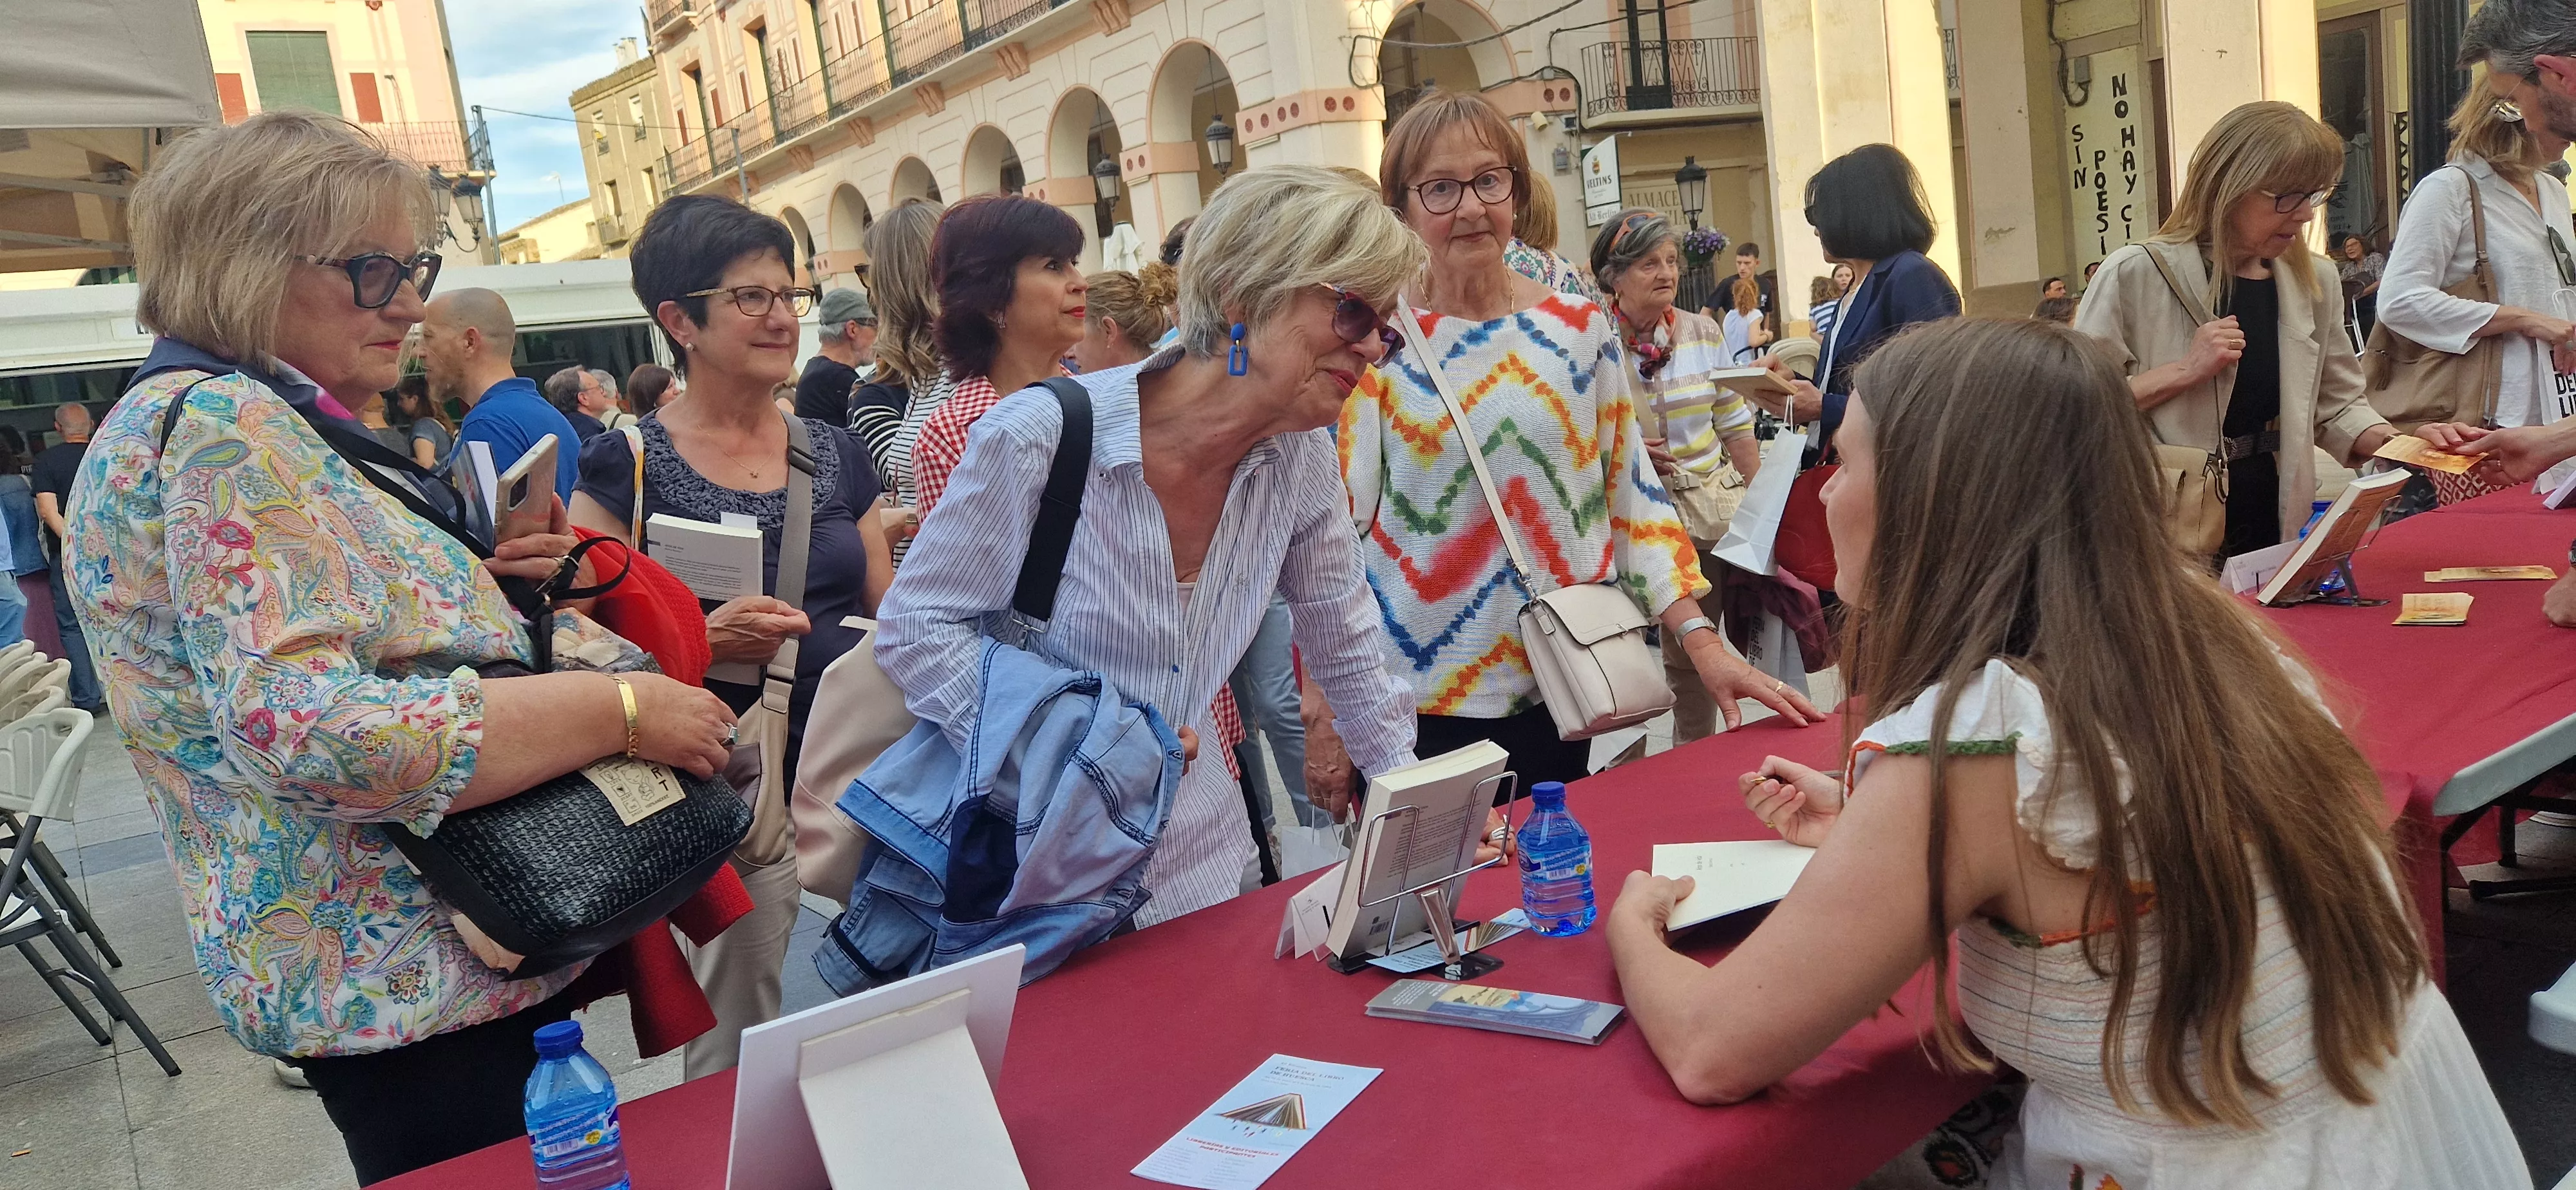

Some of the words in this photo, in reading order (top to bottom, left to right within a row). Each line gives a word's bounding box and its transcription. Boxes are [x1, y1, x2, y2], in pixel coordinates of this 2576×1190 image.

[2112, 73, 2128, 118] NO
[2072, 124, 2087, 189] SIN
[2121, 124, 2137, 194] HAY
[1586, 175, 1612, 189] VELTINS
[1627, 190, 1680, 208] ALMACE
[2094, 149, 2109, 256] POESI
[1597, 209, 1617, 220] Berlin
[2121, 204, 2134, 246] CI
[2555, 372, 2576, 395] DE
